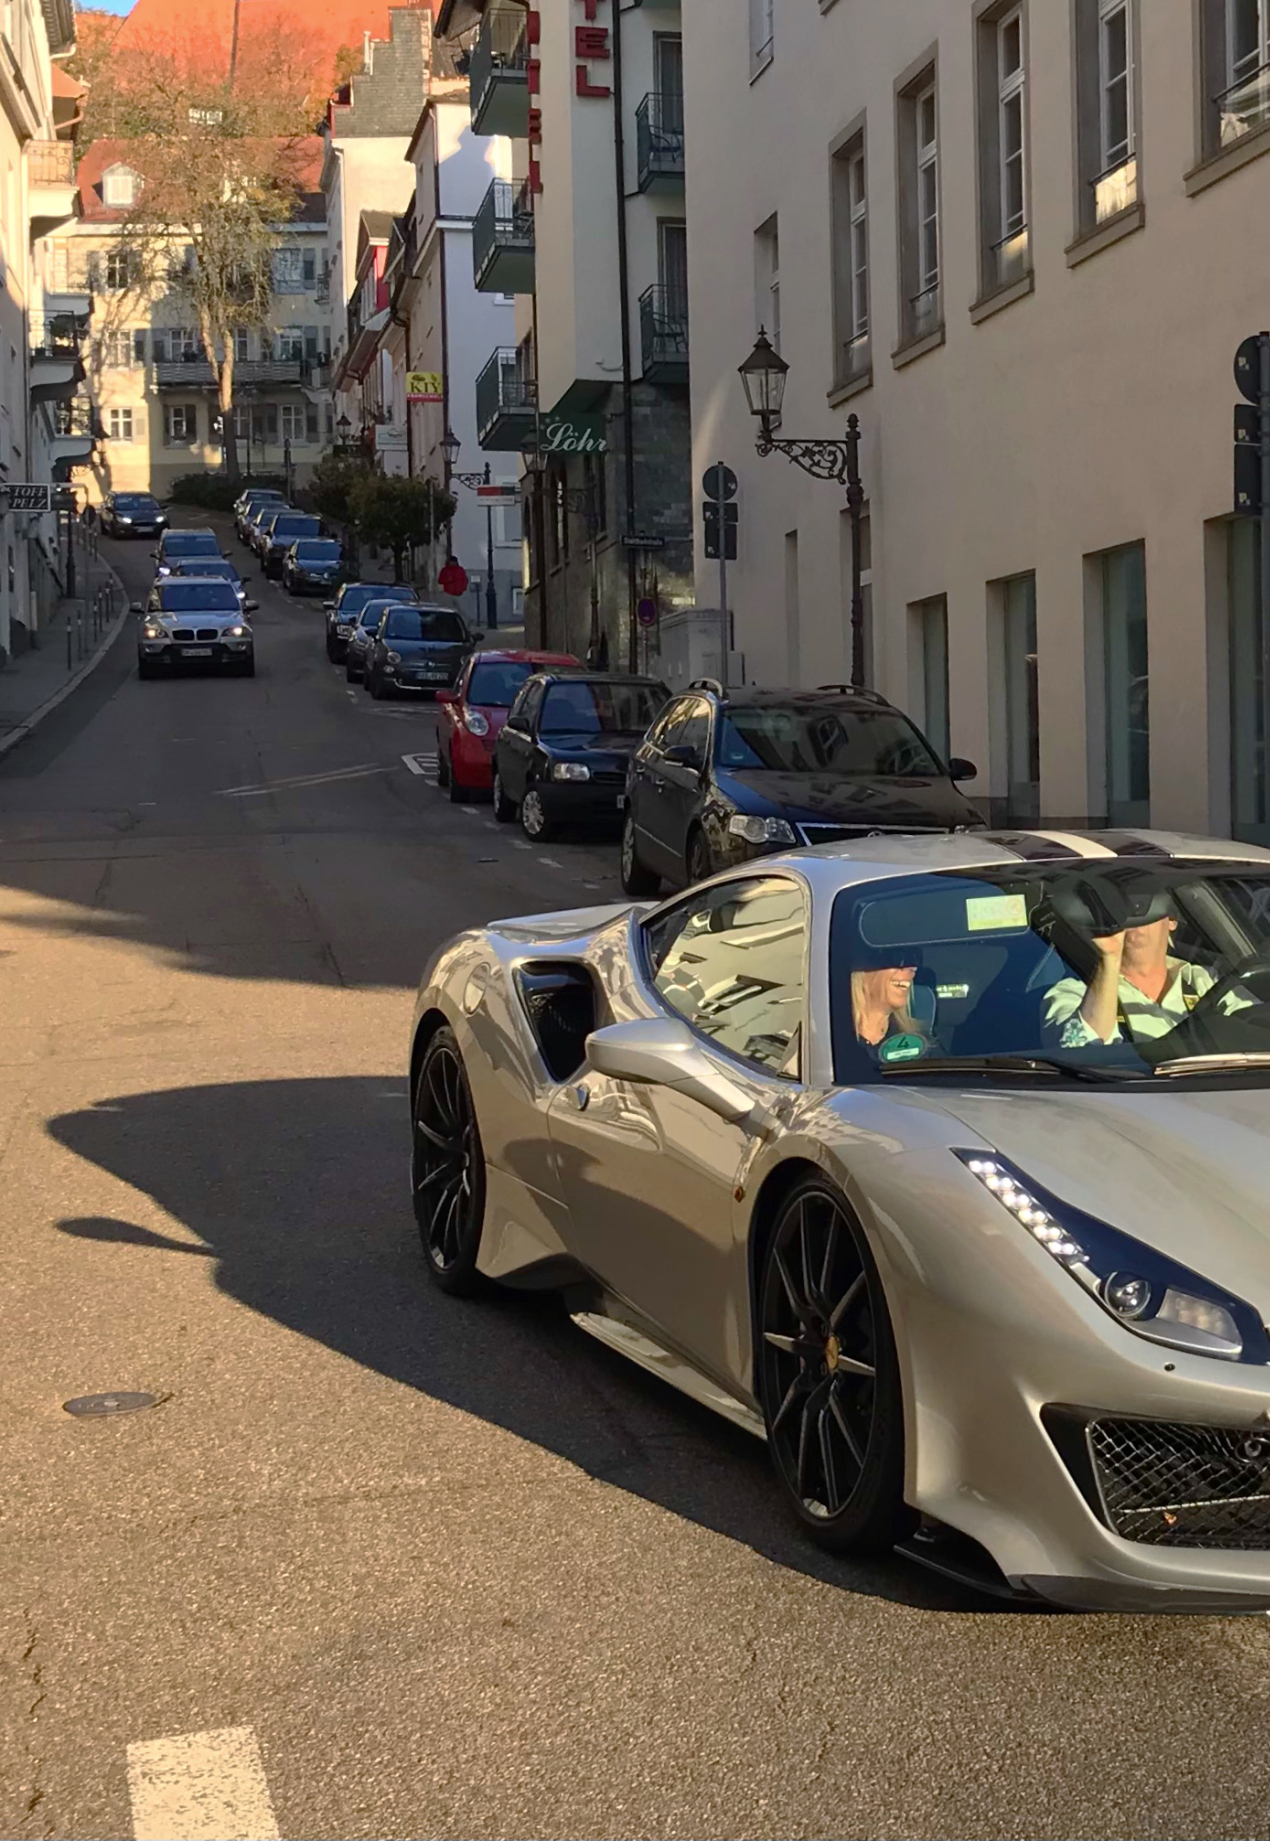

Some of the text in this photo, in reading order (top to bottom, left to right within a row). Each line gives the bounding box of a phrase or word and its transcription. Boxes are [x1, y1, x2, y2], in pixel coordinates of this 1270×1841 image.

[540, 423, 608, 452] Löhr
[12, 498, 47, 508] PELZ
[897, 1036, 910, 1049] 4
